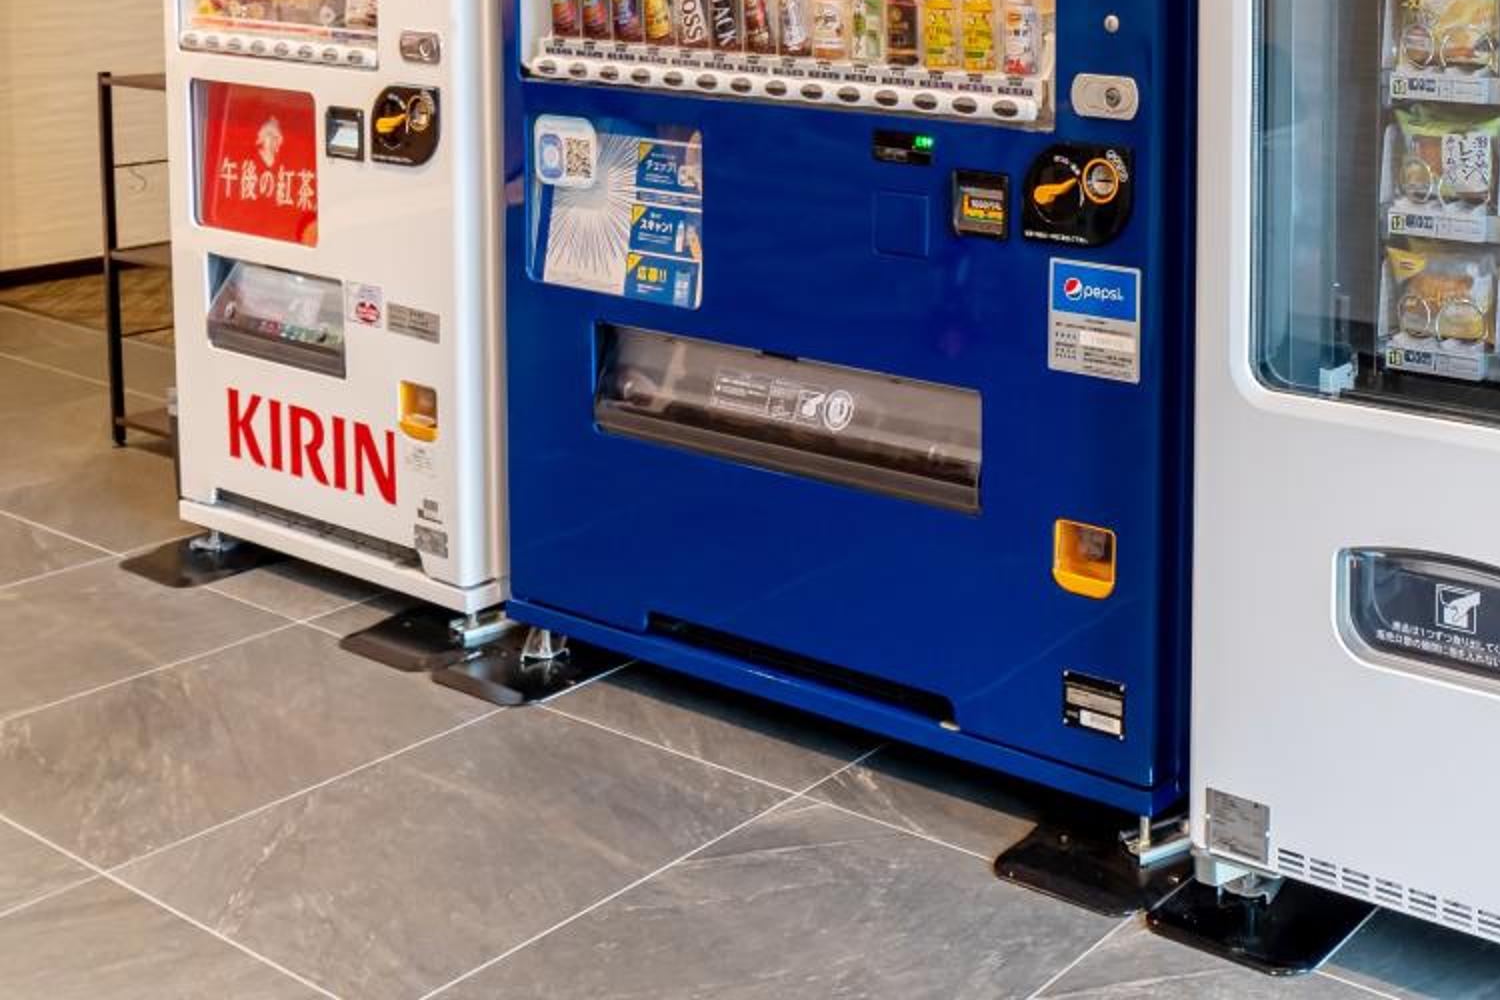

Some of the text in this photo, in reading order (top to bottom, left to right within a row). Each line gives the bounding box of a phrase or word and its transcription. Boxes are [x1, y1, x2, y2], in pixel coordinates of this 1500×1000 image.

[220, 156, 316, 213] 午後の紅茶
[1084, 285, 1121, 303] pepsi
[227, 387, 397, 506] KIRIN
